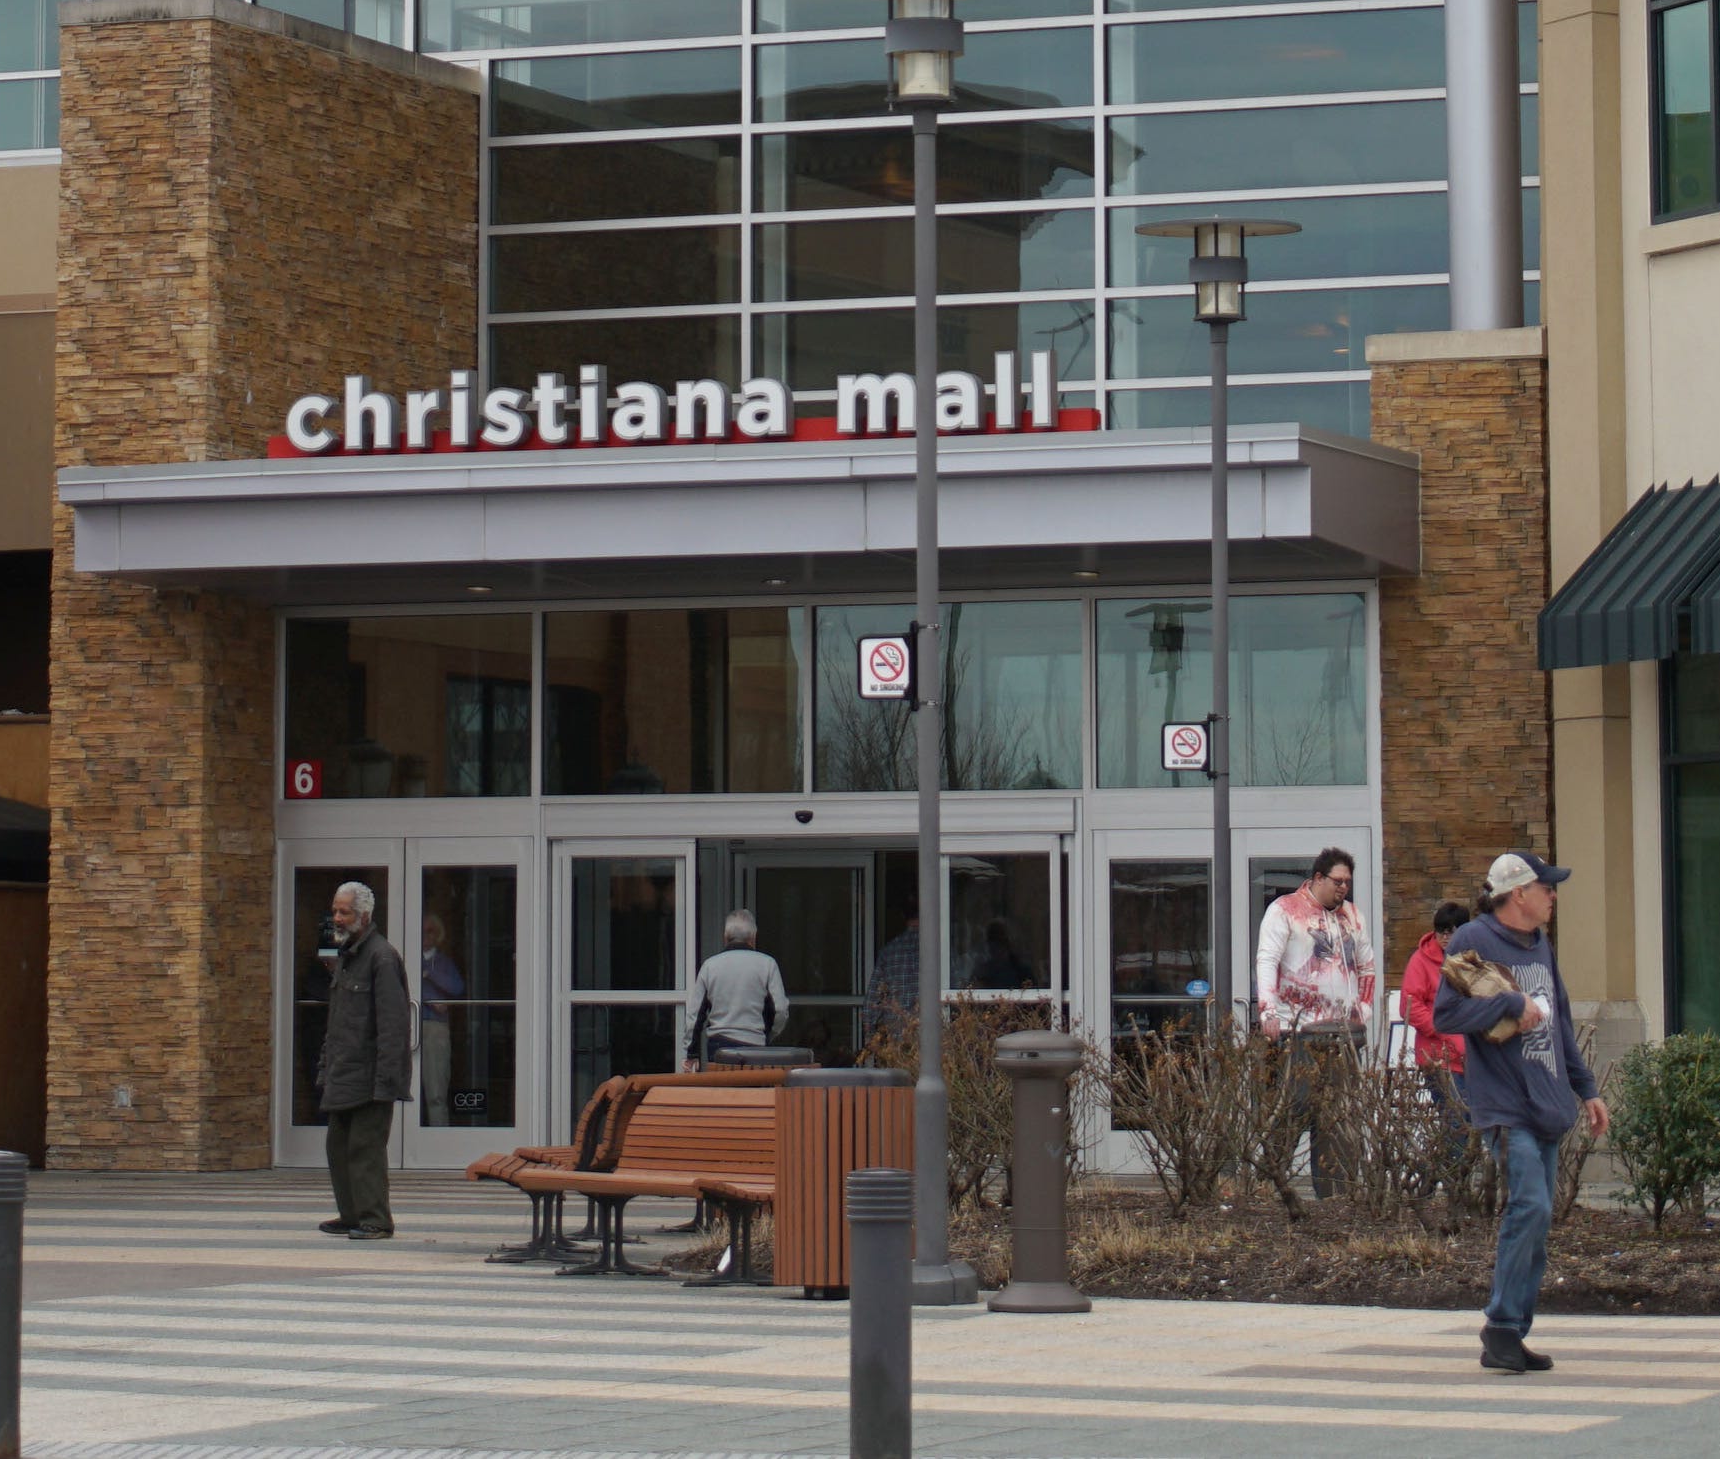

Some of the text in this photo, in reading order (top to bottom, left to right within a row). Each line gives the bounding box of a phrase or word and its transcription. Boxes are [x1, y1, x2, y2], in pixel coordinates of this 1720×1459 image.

[286, 349, 1058, 452] christiana mall
[294, 762, 314, 794] 6
[454, 1092, 485, 1107] GGP
